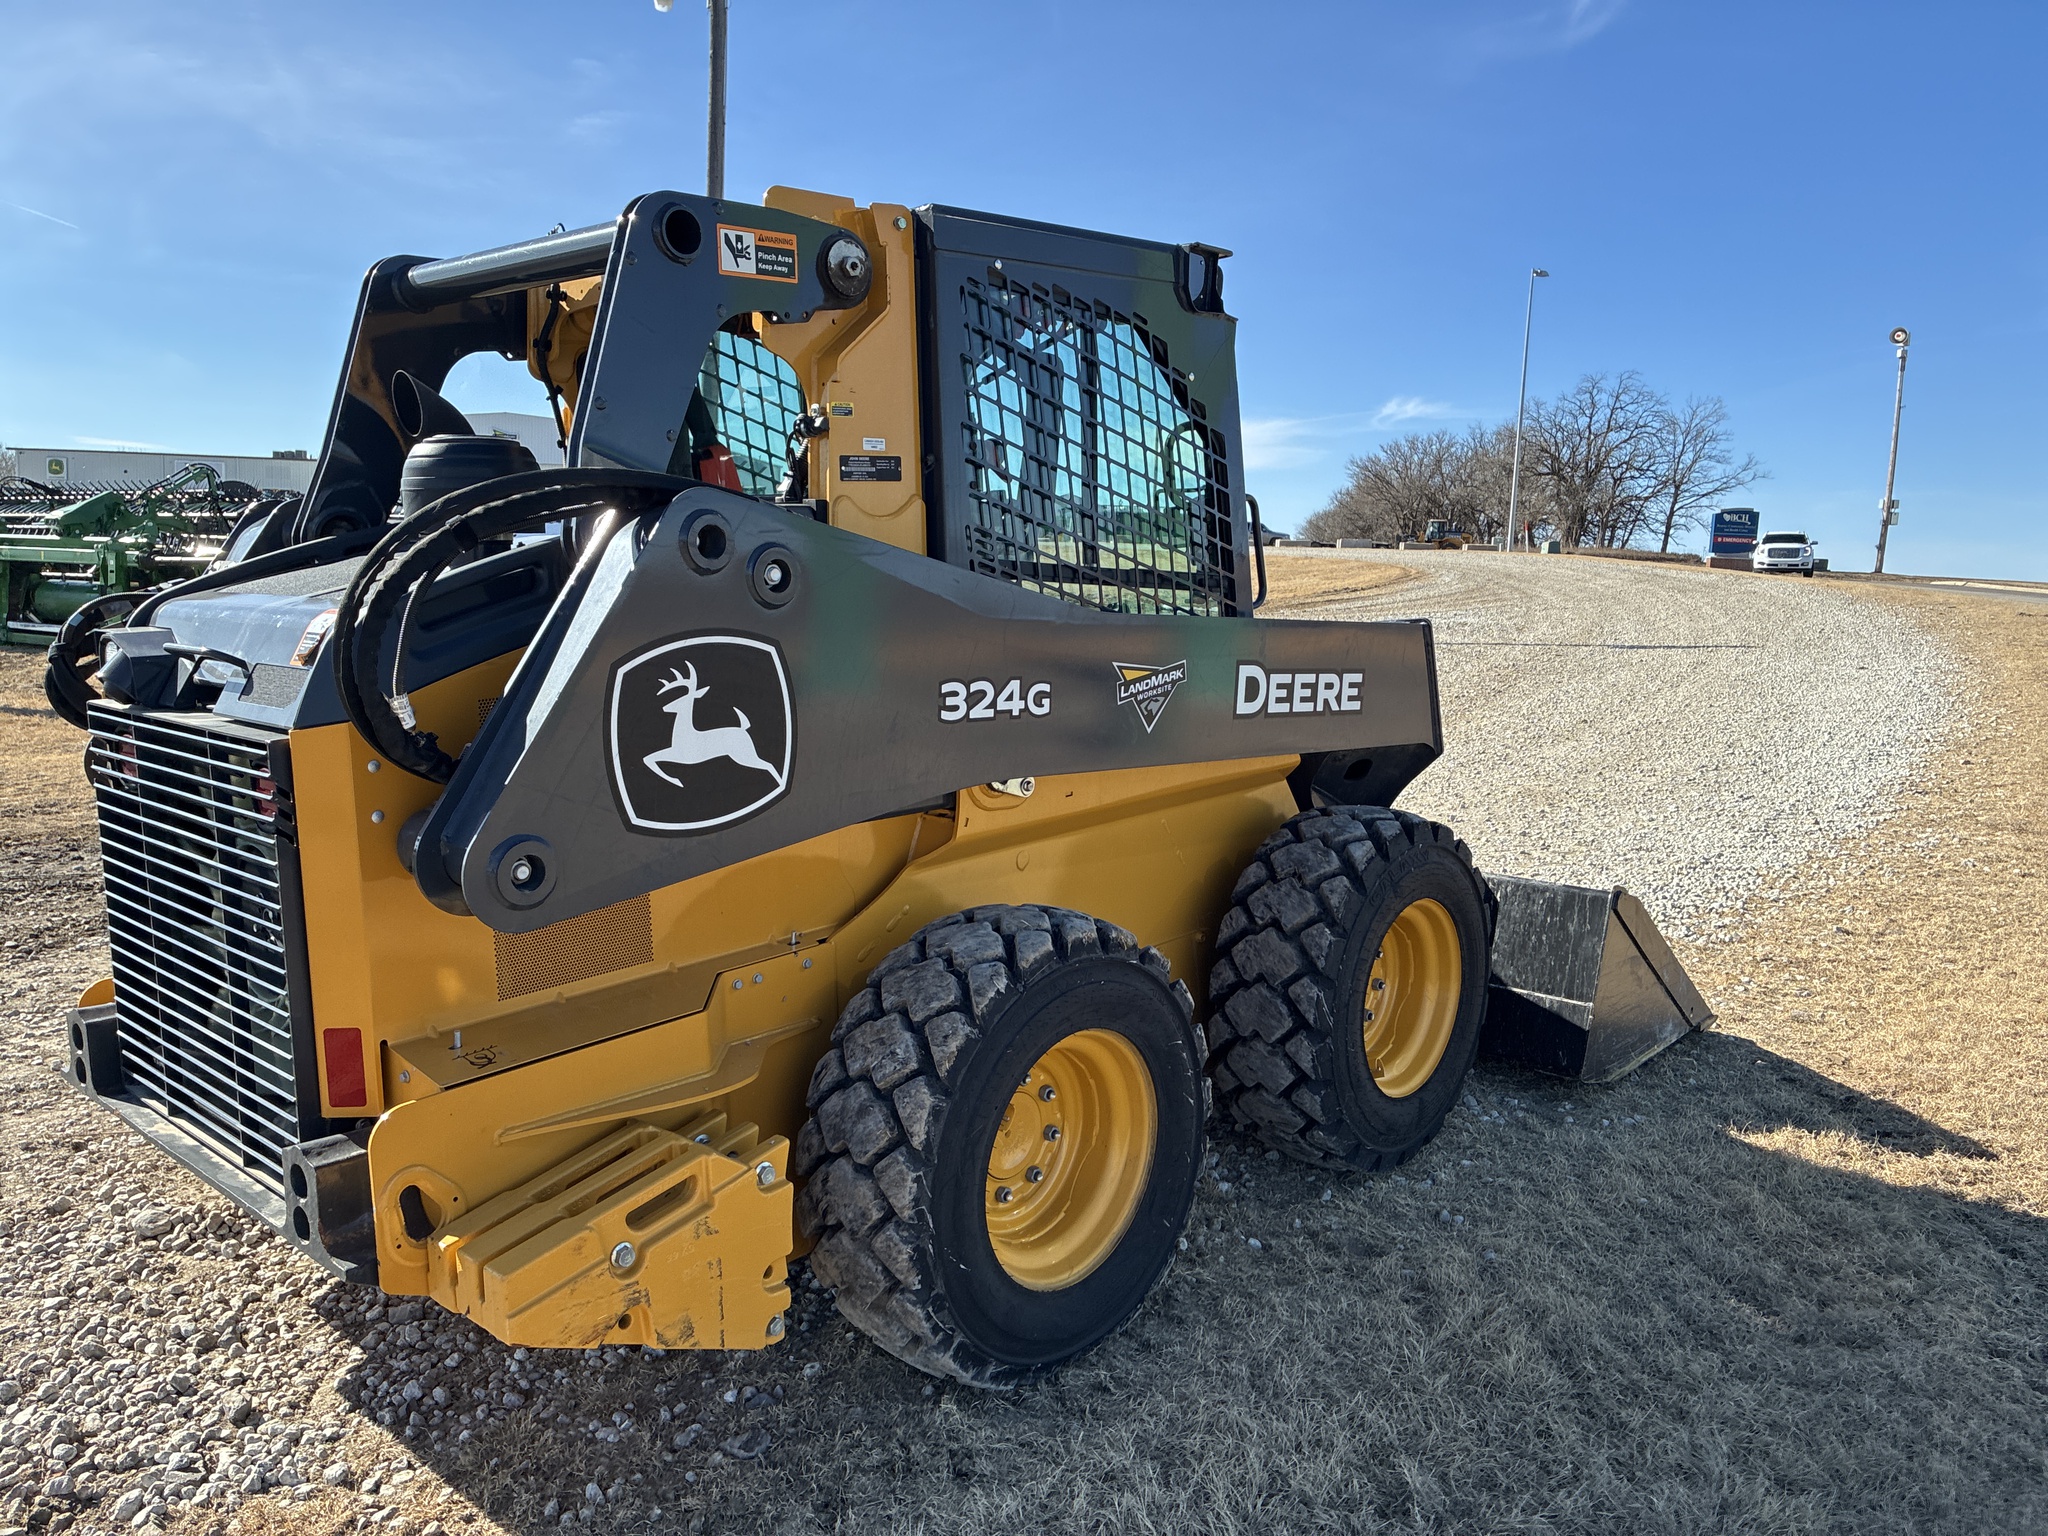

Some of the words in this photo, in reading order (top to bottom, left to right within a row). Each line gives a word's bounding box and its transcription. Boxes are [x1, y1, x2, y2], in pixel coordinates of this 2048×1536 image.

[764, 236, 793, 245] WARNING
[758, 252, 776, 261] Pinch
[778, 254, 792, 263] Area
[758, 262, 772, 271] Keep
[773, 264, 788, 273] Away
[1730, 513, 1749, 521] BCH
[1120, 667, 1184, 698] LANDMARK
[1236, 663, 1363, 715] DEERE
[939, 680, 1051, 722] 324G
[1136, 683, 1173, 701] WORKSITE
[1368, 846, 1430, 907] GALAXY
